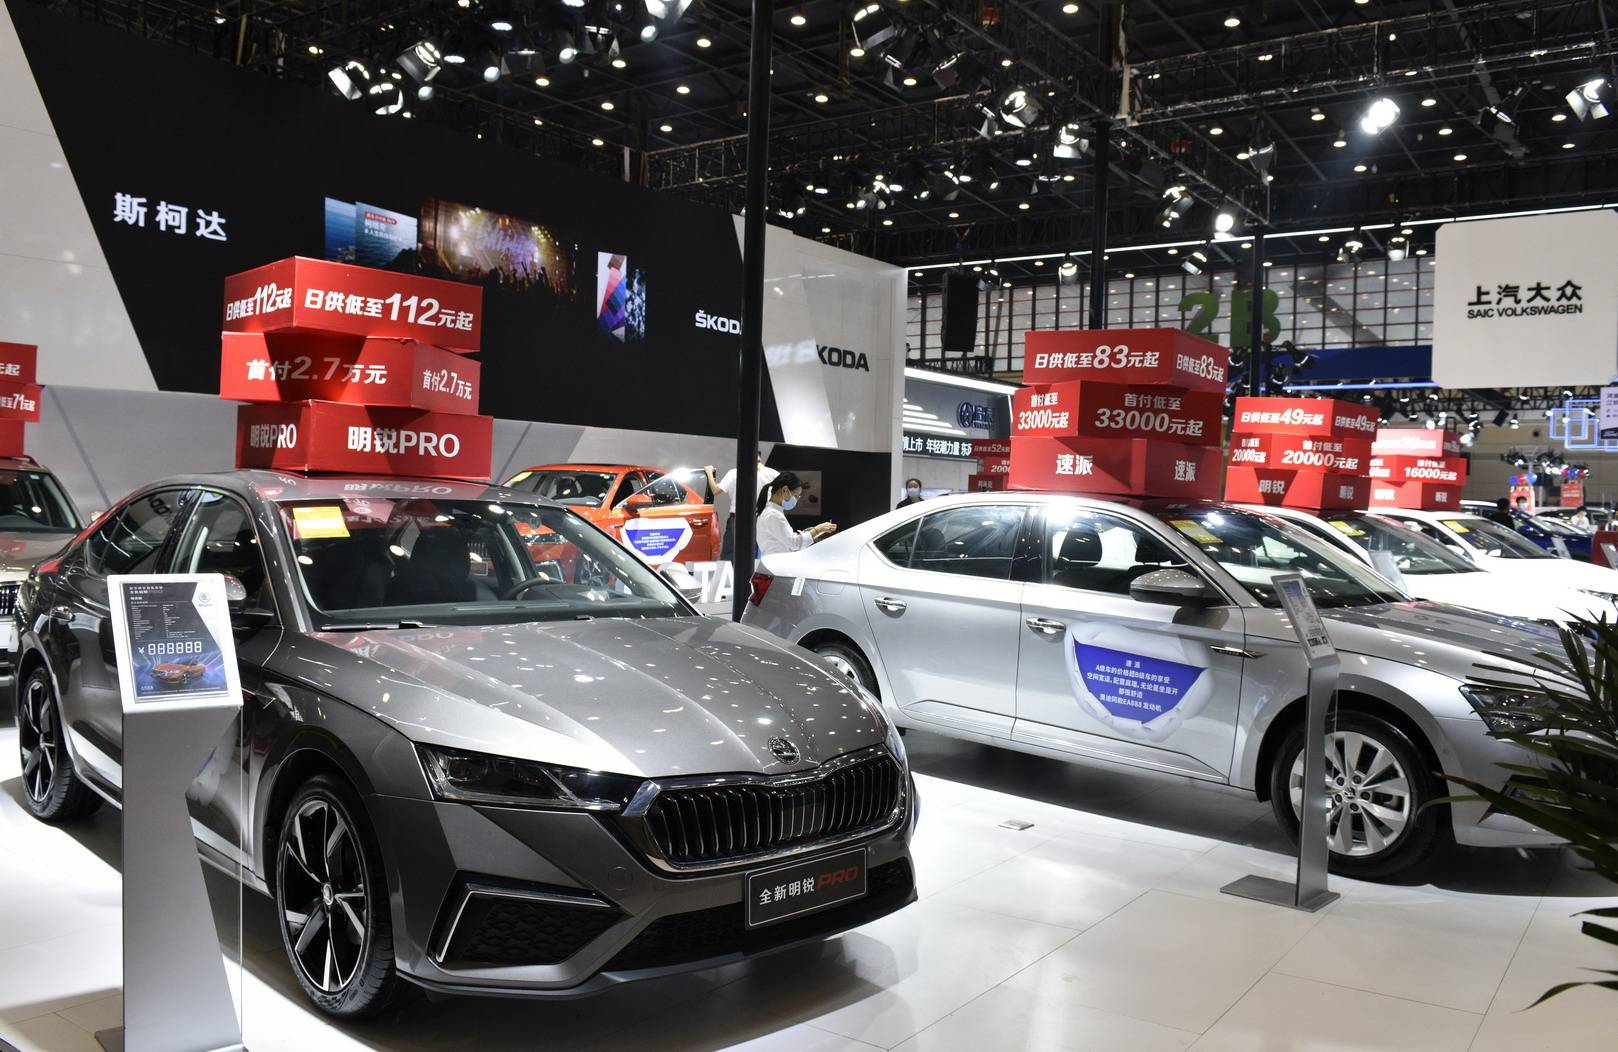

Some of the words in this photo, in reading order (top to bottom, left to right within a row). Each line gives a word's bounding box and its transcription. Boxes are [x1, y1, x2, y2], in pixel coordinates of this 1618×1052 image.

[113, 192, 227, 241] 斯柯达
[226, 283, 292, 321] 日供低至112元起
[1468, 280, 1582, 306] 上汽大众
[304, 288, 474, 331] 日供低至112元起
[695, 309, 742, 335] ŠKOD
[1467, 308, 1495, 319] SAIC
[1497, 304, 1583, 317] VOLKSWAGEN
[1034, 344, 1160, 369] 日供低至83元起
[1176, 354, 1225, 383] 日供低至83元起
[246, 356, 388, 386] 首付2.7万元
[422, 369, 473, 401] 首付2.7万元
[1030, 392, 1059, 408] 首付低至
[1124, 393, 1182, 410] 首付低至
[1018, 409, 1070, 430] 33000元起
[1095, 408, 1204, 437] 33000元起
[1241, 408, 1324, 426] 日供低至49元起
[250, 423, 297, 449] 明锐PRO
[347, 426, 460, 458] 明锐PRO
[1302, 440, 1343, 452] 首付低至
[991, 465, 1010, 473] 200
[1055, 454, 1094, 475] 速派
[1174, 460, 1196, 482] 速派
[1281, 450, 1358, 470] 20000元起
[1259, 480, 1285, 494] 明锐
[759, 866, 858, 905] 全新明锐PRO
